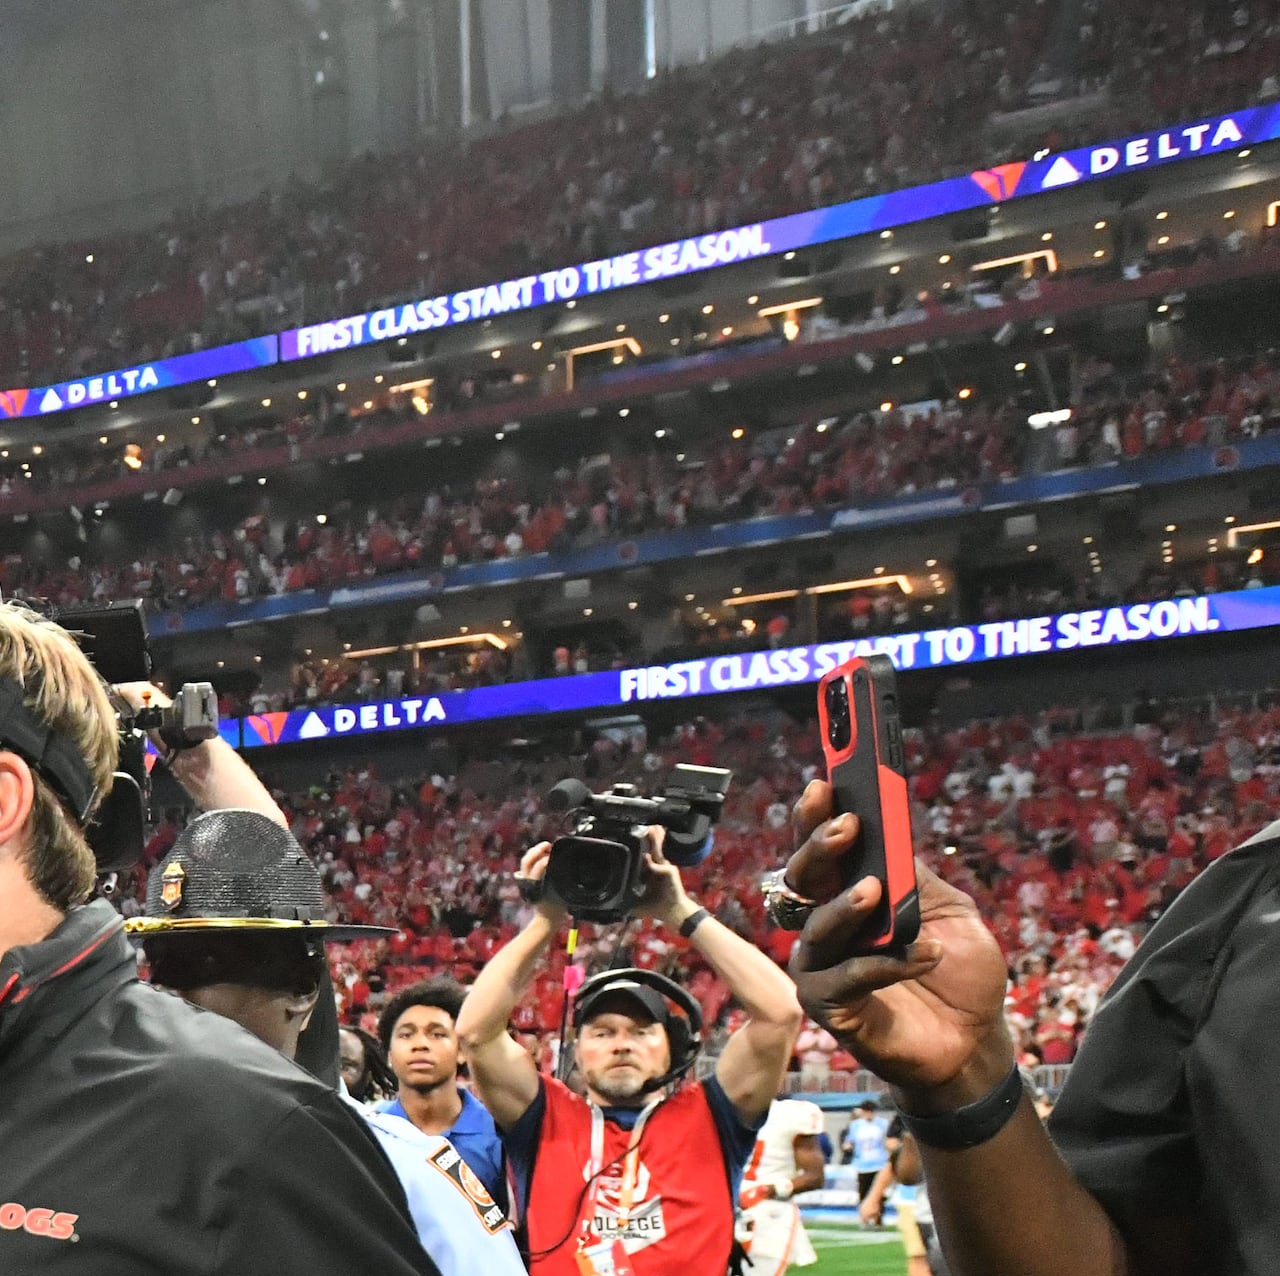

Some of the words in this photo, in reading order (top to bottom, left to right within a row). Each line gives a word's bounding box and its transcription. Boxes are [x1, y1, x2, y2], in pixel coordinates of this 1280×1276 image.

[1091, 118, 1242, 174] DELTA
[297, 315, 367, 357] FIRST
[369, 296, 449, 340] CLASS
[452, 276, 536, 322] START
[540, 267, 580, 302] TO
[583, 251, 640, 292] THE
[644, 224, 771, 281] SEASON.
[68, 366, 159, 404] DELTA
[620, 660, 708, 702] FIRST
[710, 648, 811, 691] CLASS
[924, 627, 975, 665] TO
[979, 617, 1052, 658] THE
[1057, 596, 1220, 649] SEASON.
[334, 697, 447, 732] DELTA
[593, 1215, 663, 1232] OLEGE
